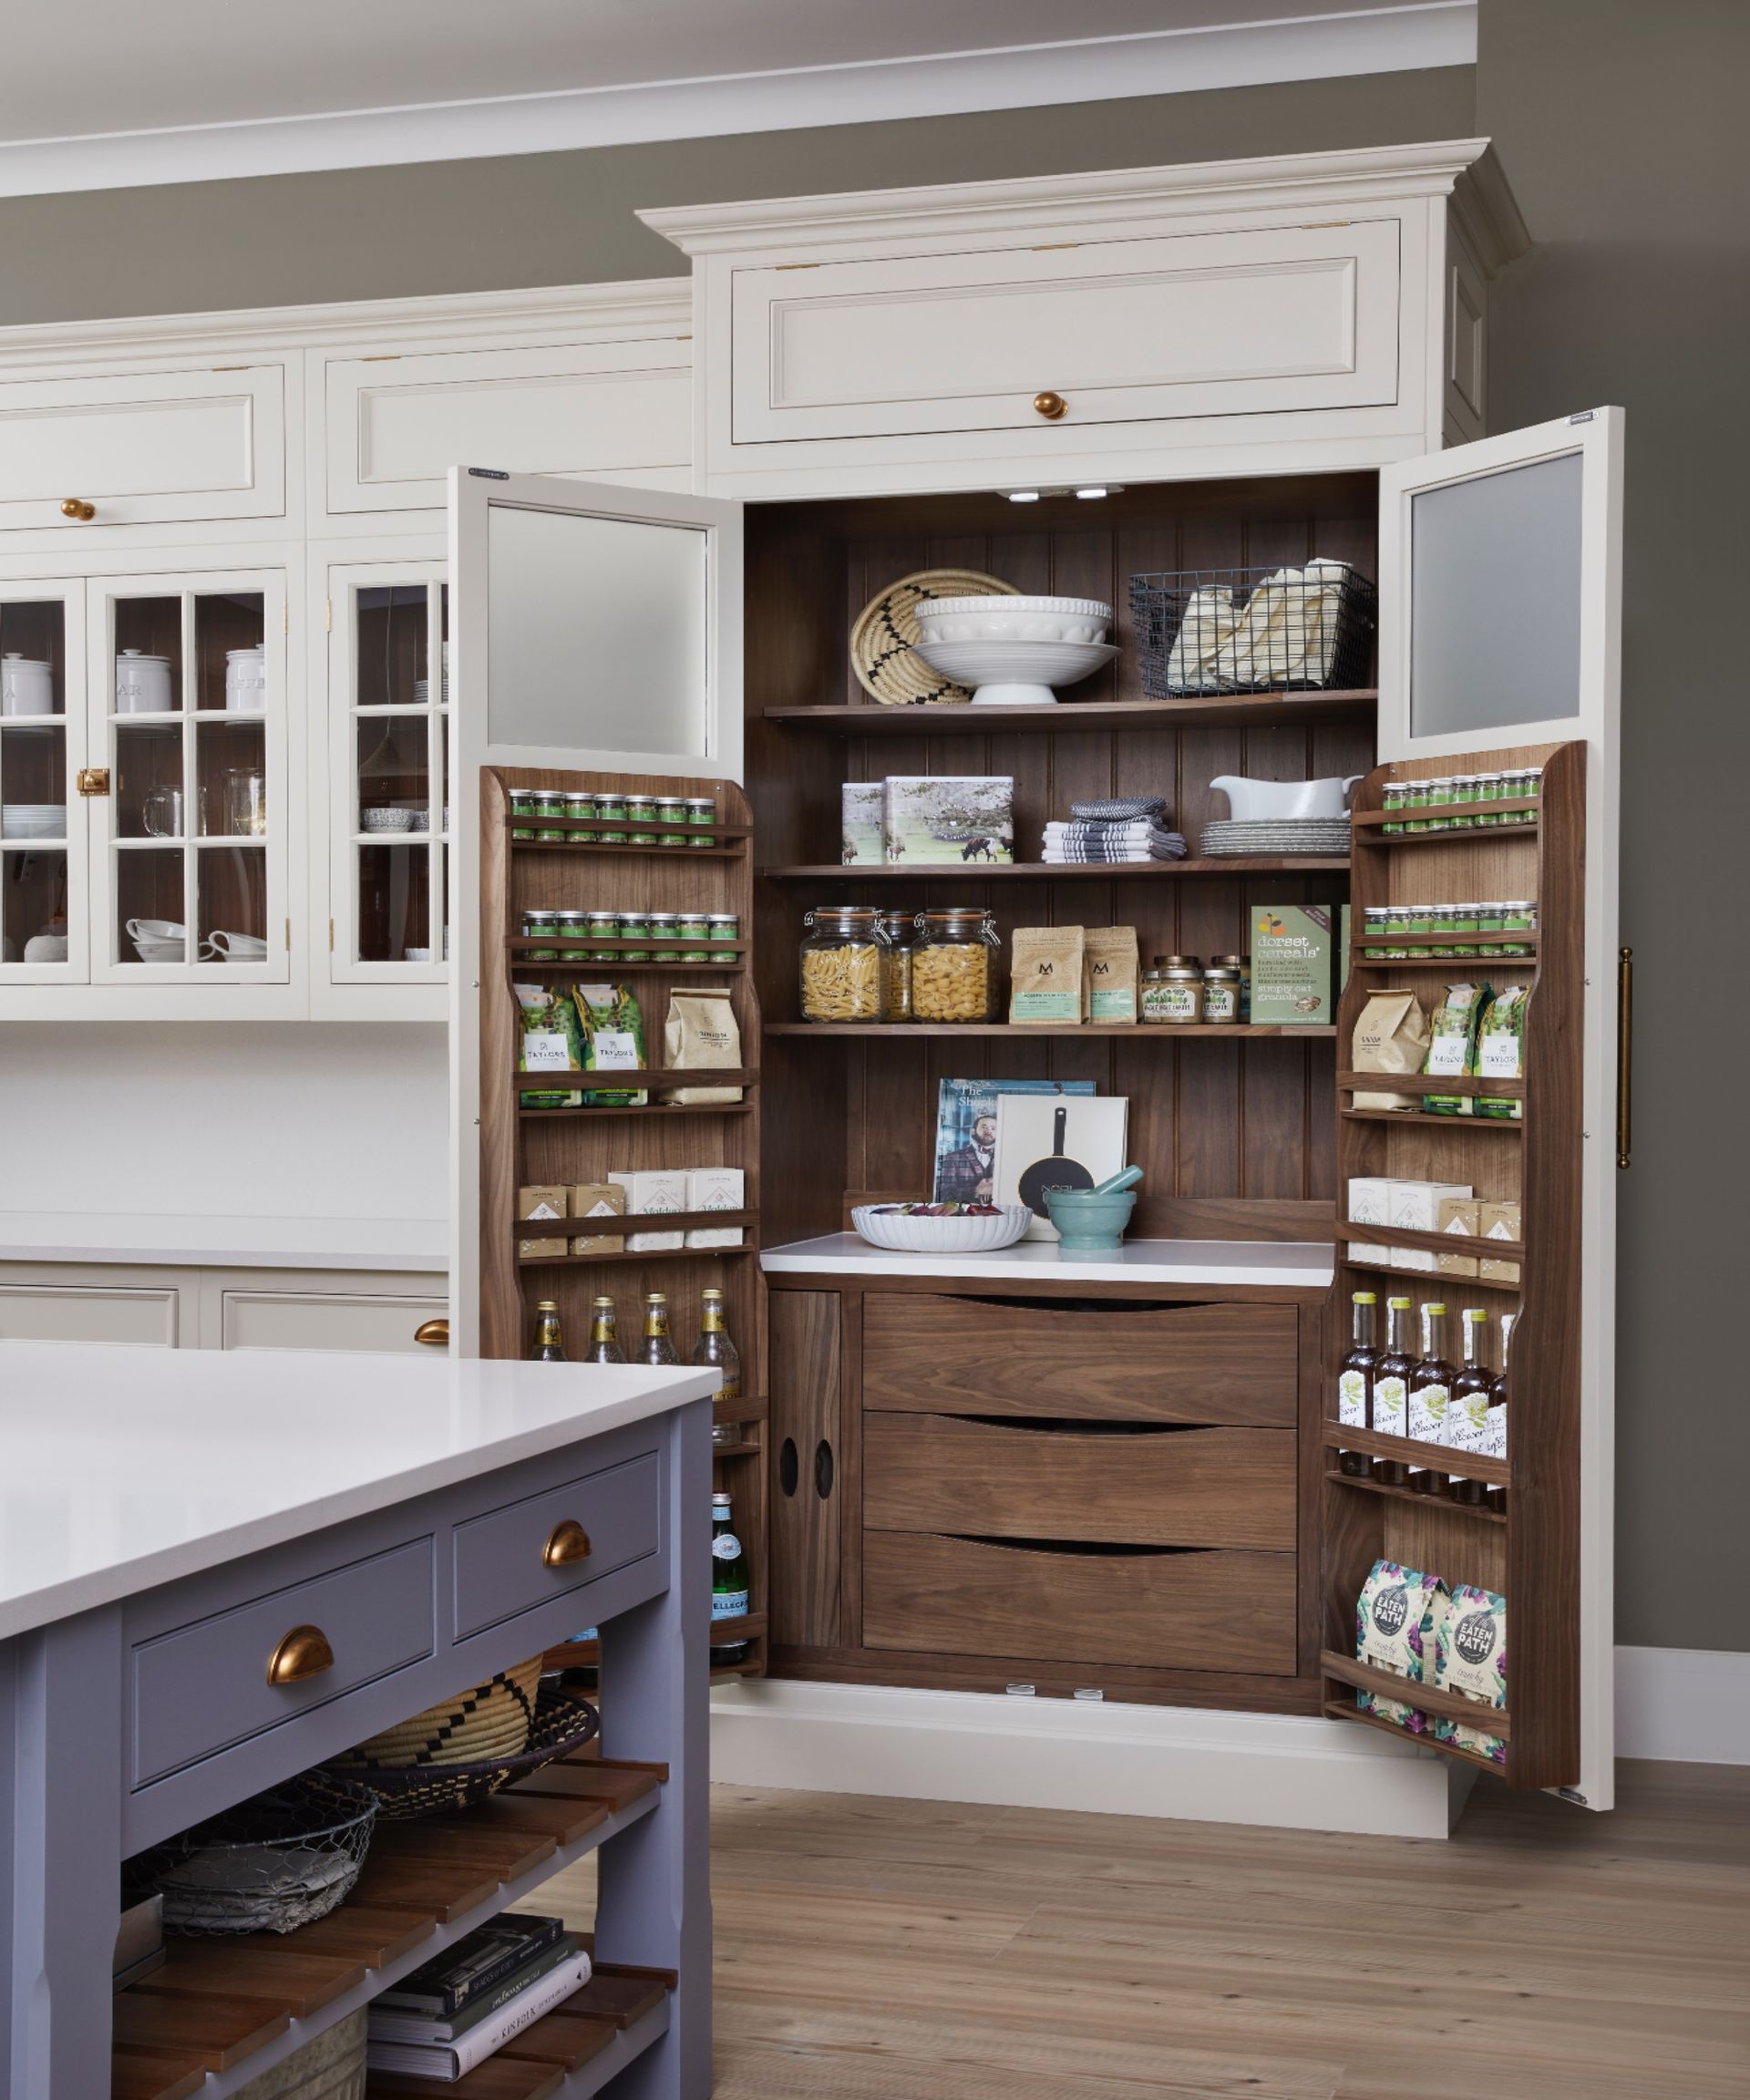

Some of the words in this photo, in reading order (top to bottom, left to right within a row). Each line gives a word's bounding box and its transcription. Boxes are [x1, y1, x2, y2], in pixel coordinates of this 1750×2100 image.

[1257, 935, 1310, 948] dorset
[962, 1085, 983, 1096] The
[1376, 1596, 1405, 1614] EATEN
[1375, 1606, 1403, 1626] PATH
[1459, 1622, 1494, 1642] EATEN
[1457, 1632, 1489, 1654] PATH
